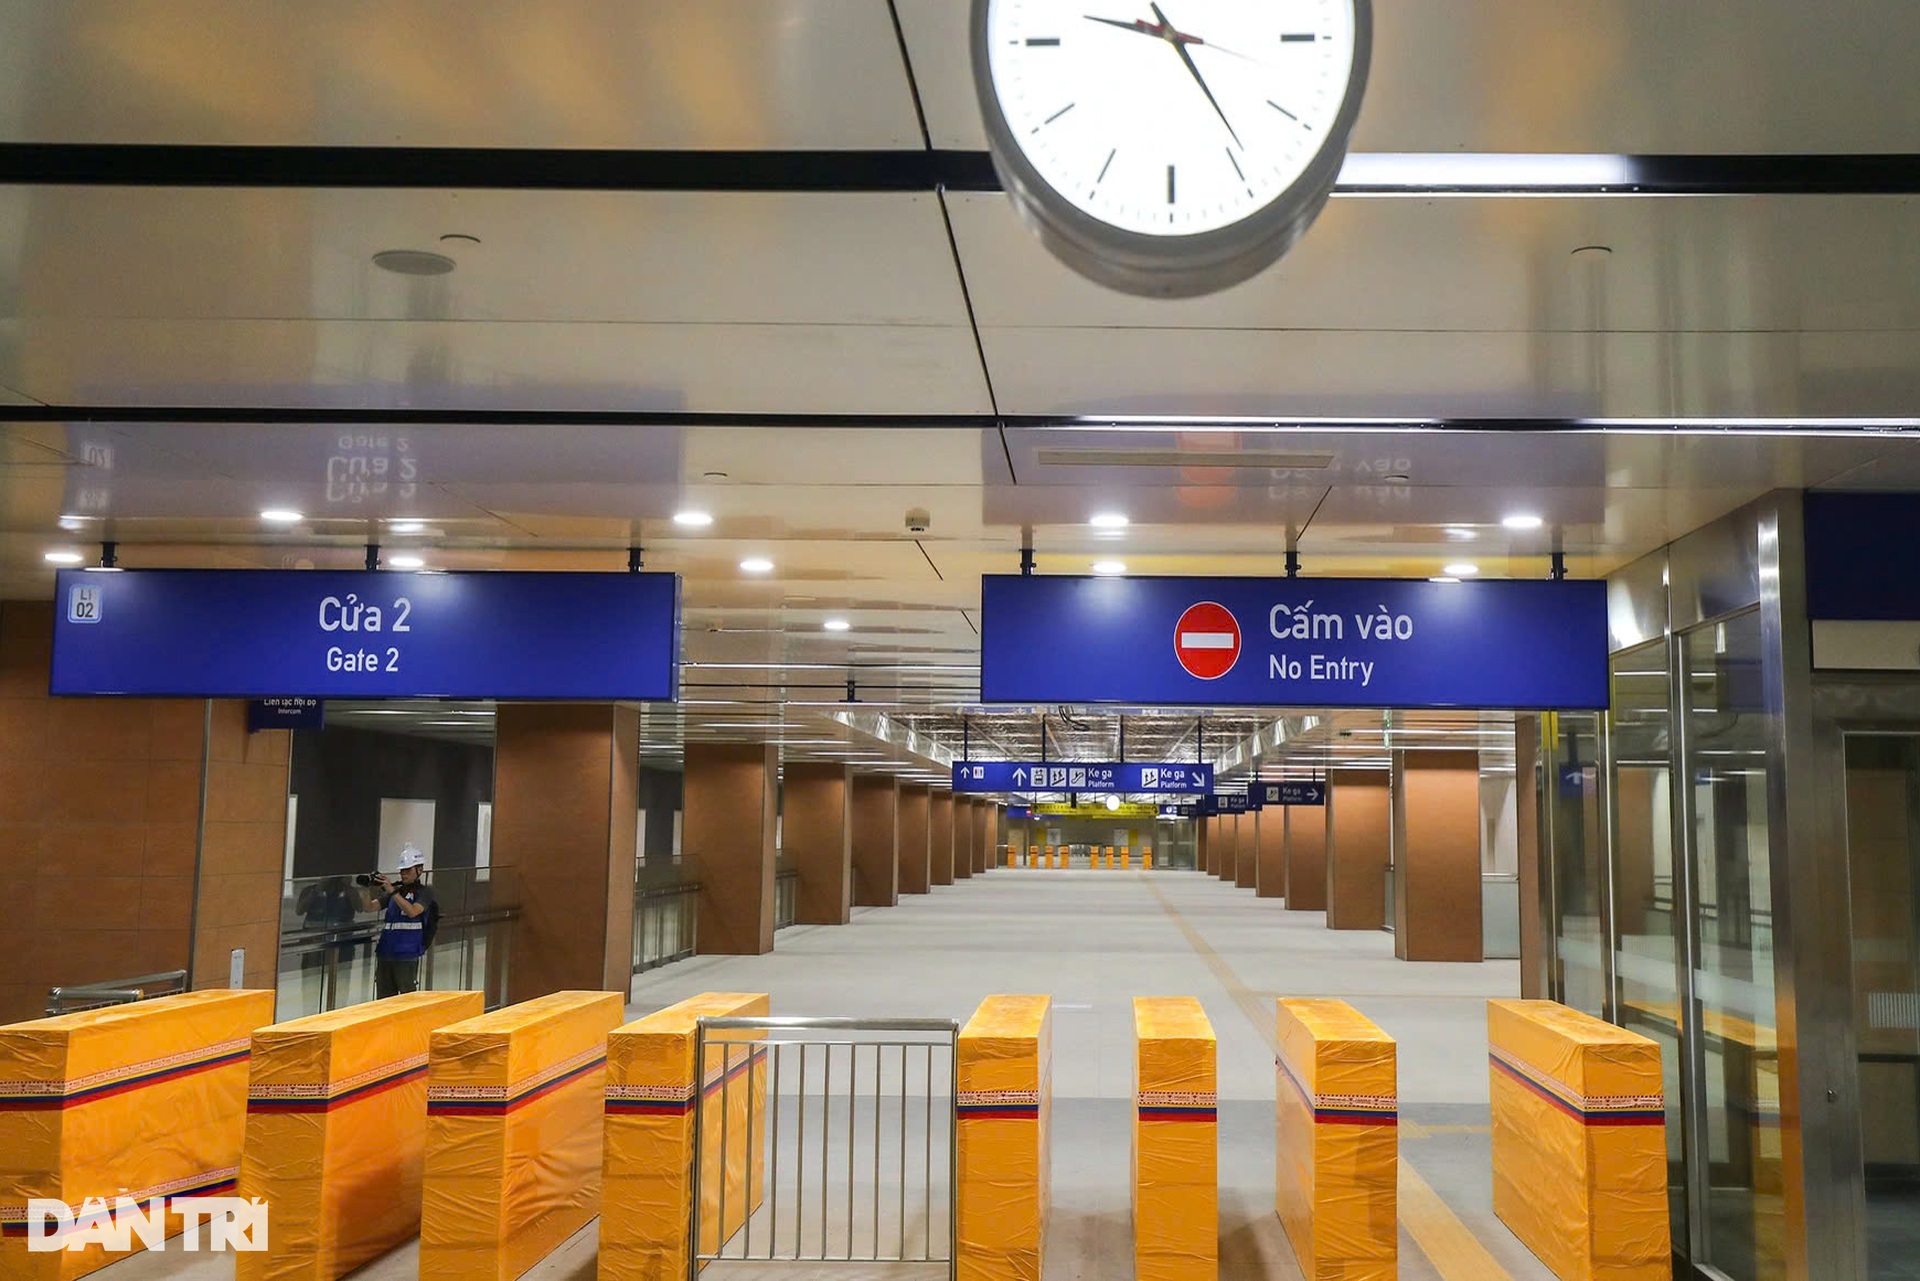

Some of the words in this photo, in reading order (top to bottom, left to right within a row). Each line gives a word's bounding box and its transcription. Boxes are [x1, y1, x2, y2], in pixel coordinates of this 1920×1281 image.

[76, 602, 94, 618] 02
[318, 593, 381, 632] Cửa
[392, 597, 411, 632] 2
[1269, 600, 1343, 640] Cấm
[1355, 605, 1413, 640] vào
[326, 647, 378, 672] Gate
[385, 647, 399, 672] 2
[1269, 654, 1302, 680] No
[1310, 655, 1374, 687] Entry
[1088, 768, 1100, 778] Ke
[1101, 770, 1112, 780] ga
[1160, 768, 1172, 778] Ke
[1174, 770, 1185, 780] ga
[1088, 780, 1115, 788] Platform
[1160, 781, 1187, 789] Platform
